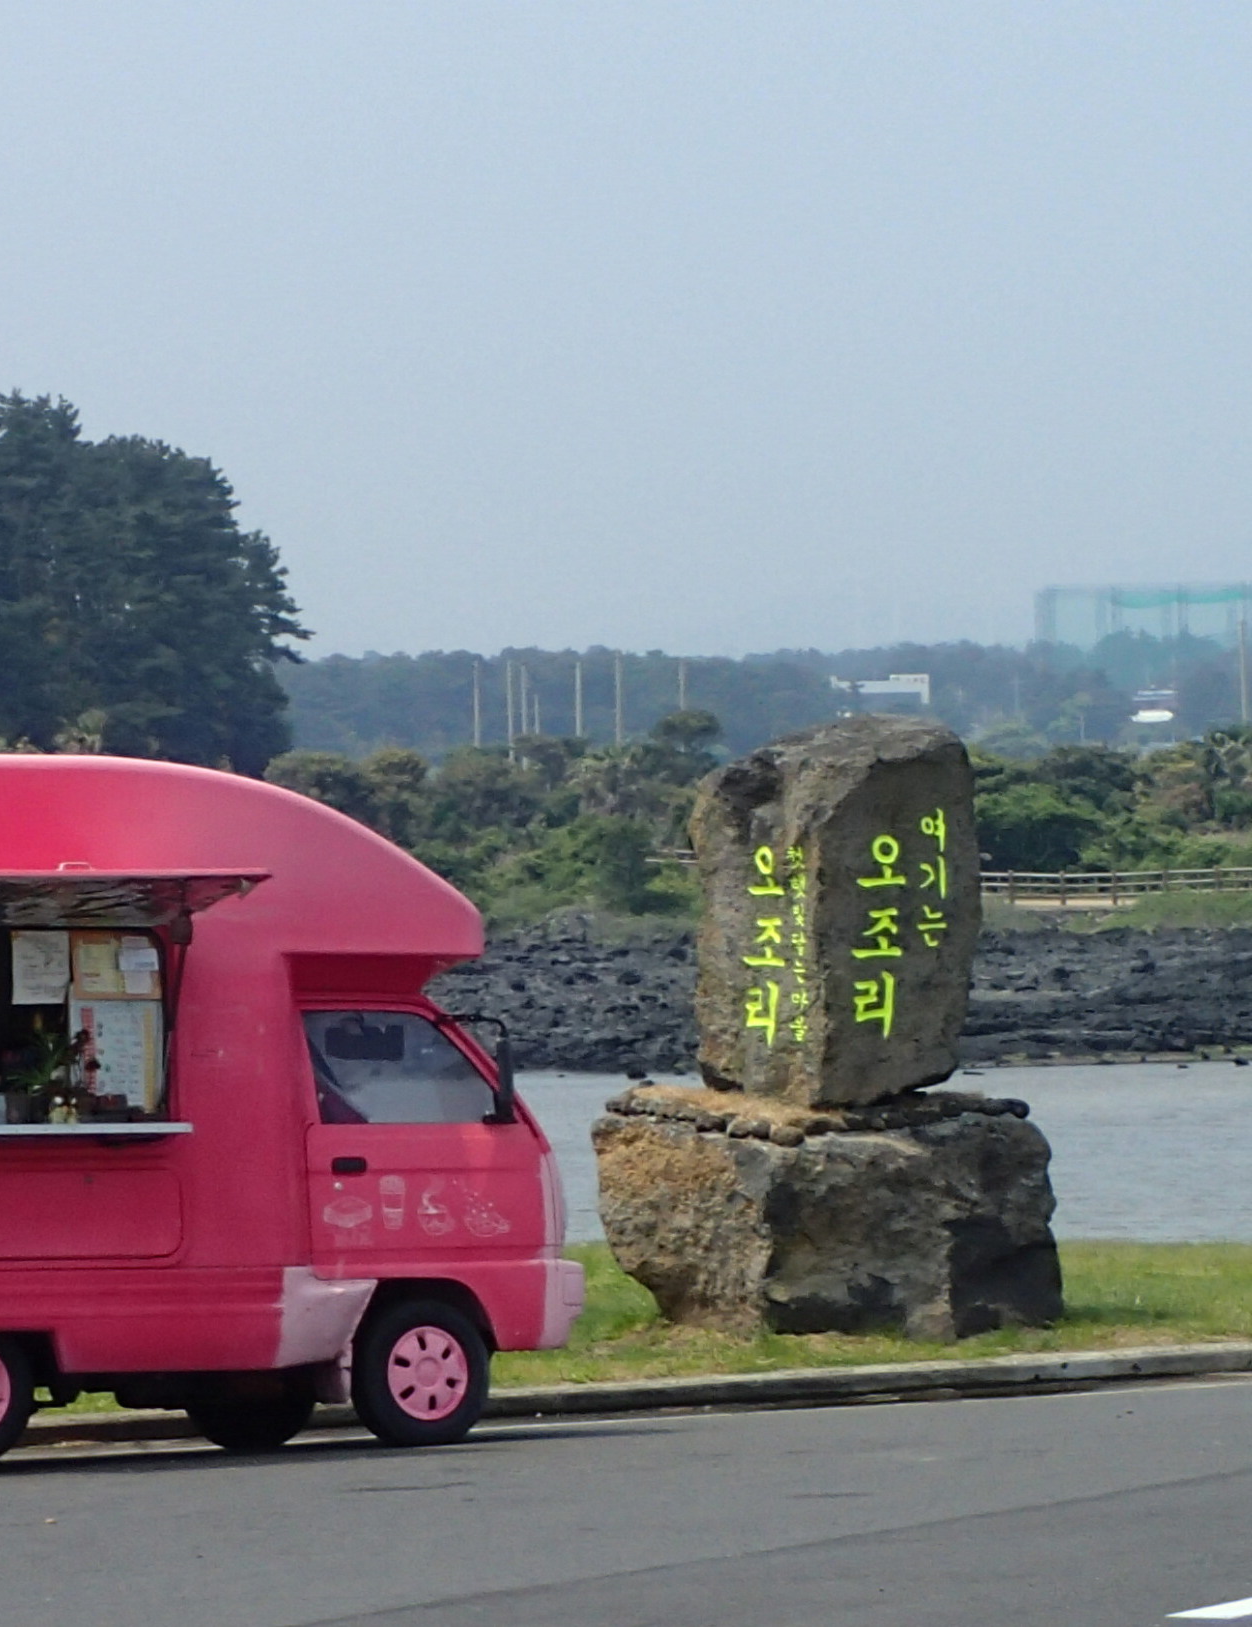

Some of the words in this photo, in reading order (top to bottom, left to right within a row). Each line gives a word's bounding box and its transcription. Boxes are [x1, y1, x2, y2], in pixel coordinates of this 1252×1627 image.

[742, 846, 786, 1047] 오조리
[851, 834, 906, 1039] 오조리
[916, 807, 947, 947] 여기는
